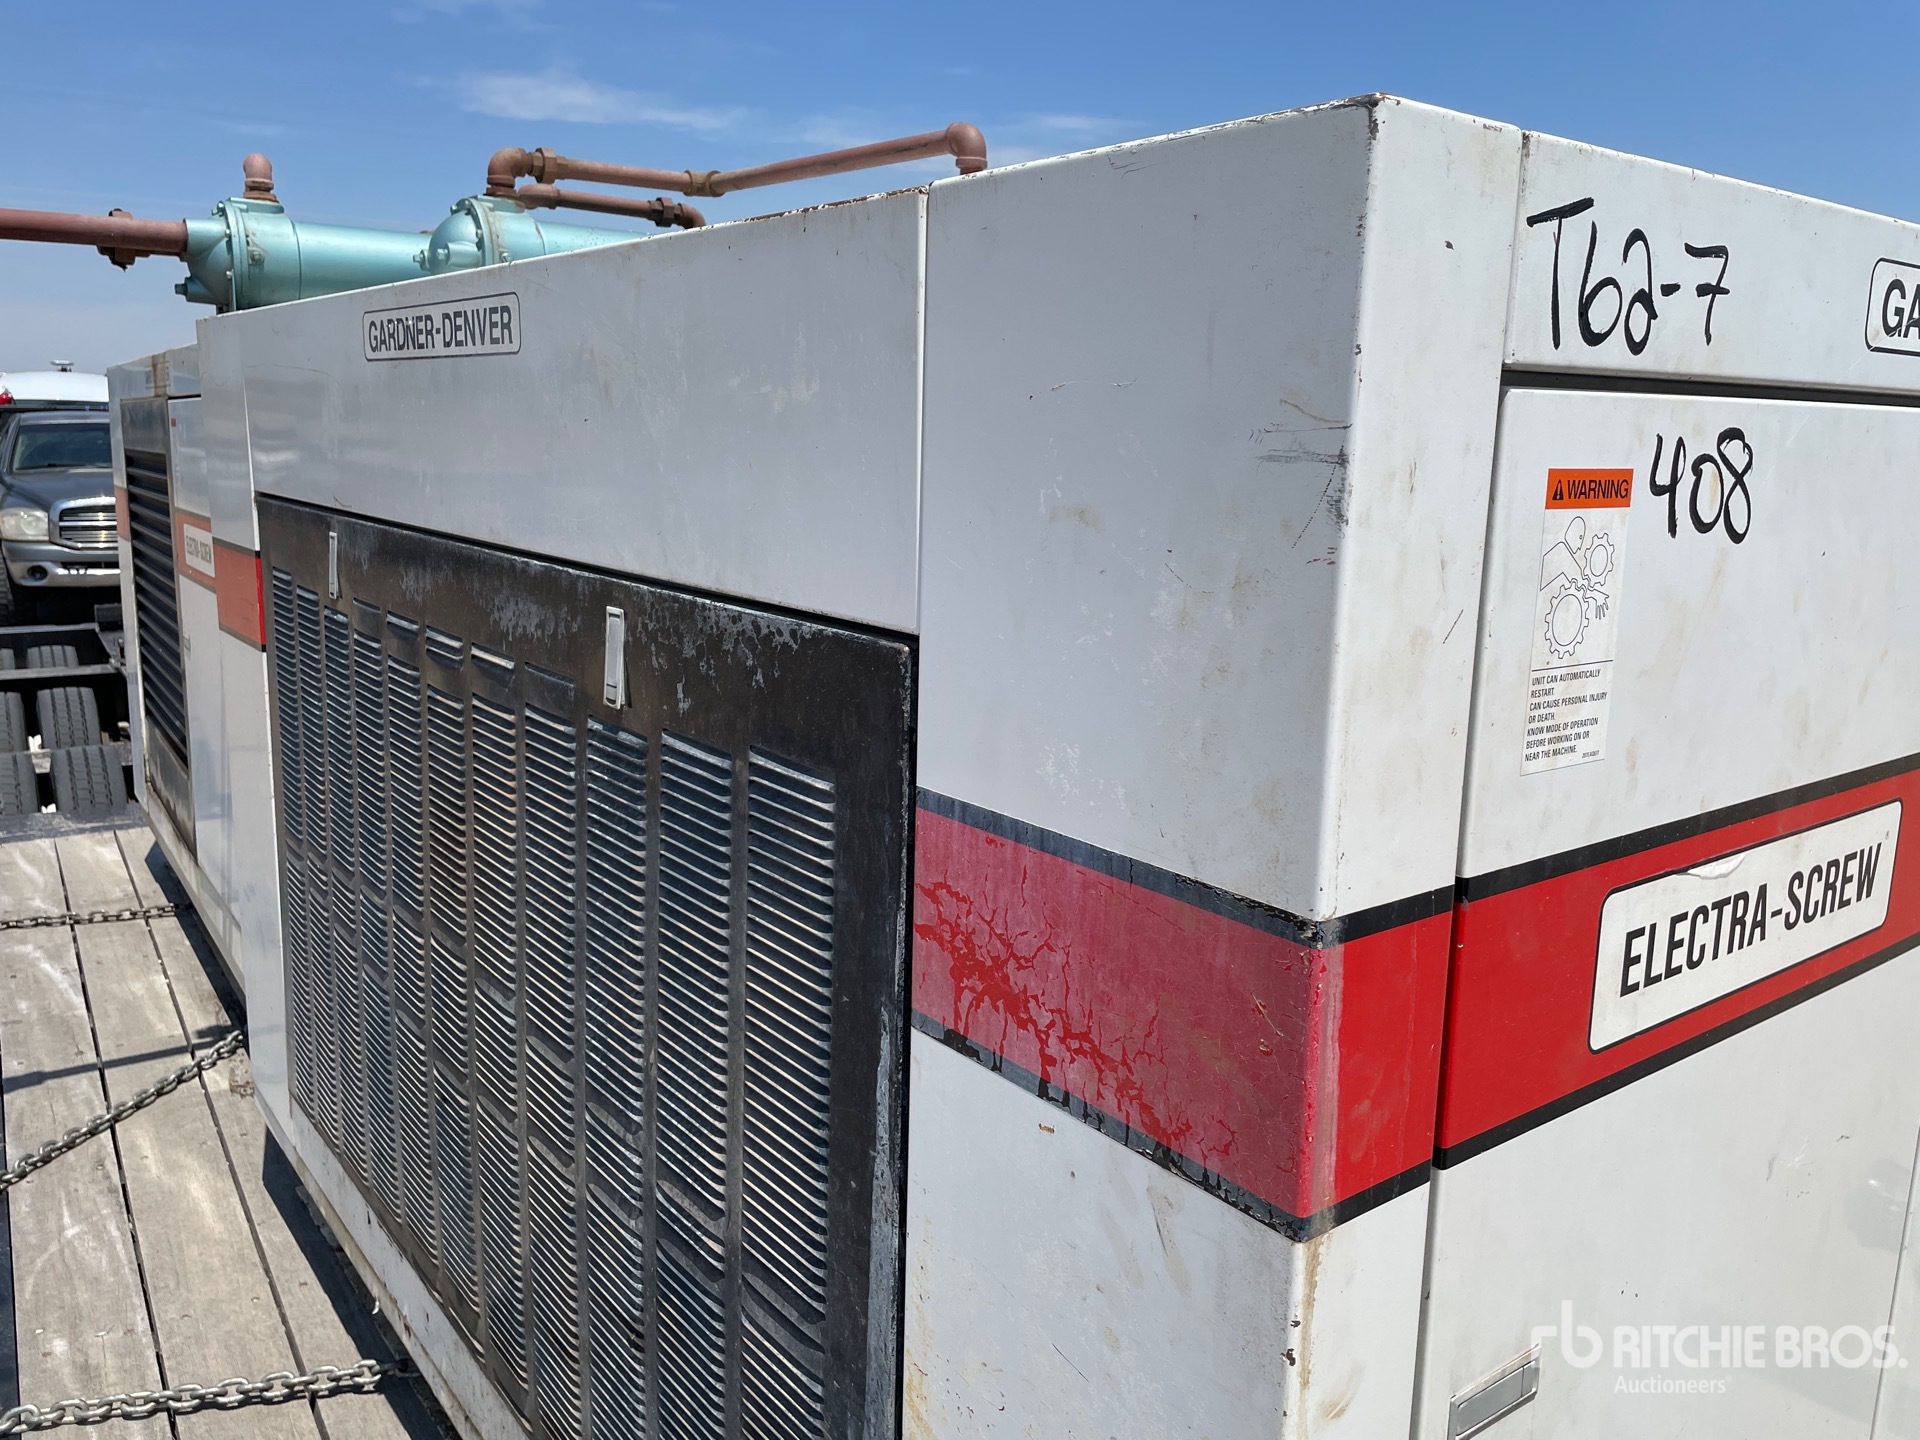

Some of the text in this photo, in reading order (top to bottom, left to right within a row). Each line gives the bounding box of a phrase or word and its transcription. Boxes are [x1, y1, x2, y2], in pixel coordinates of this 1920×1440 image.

[1526, 196, 1731, 356] T62-7
[368, 305, 514, 353] GARDNER-DENVER
[1567, 479, 1629, 500] WARNING
[1649, 426, 1754, 545] 408
[1532, 668, 1601, 686] UNIT CAN AUTOMATICALLY
[1530, 692, 1607, 711] CAN CAUSE PERSONAL INJURY
[1527, 717, 1599, 737] KNOW MODE OF OPERATION
[1528, 715, 1536, 724] OR
[1526, 730, 1590, 749] BEFORE WORKING ON OR
[1525, 751, 1540, 762] NEAR
[1541, 749, 1551, 759] THE
[1619, 841, 1883, 998] ELECTRA-SCREW
